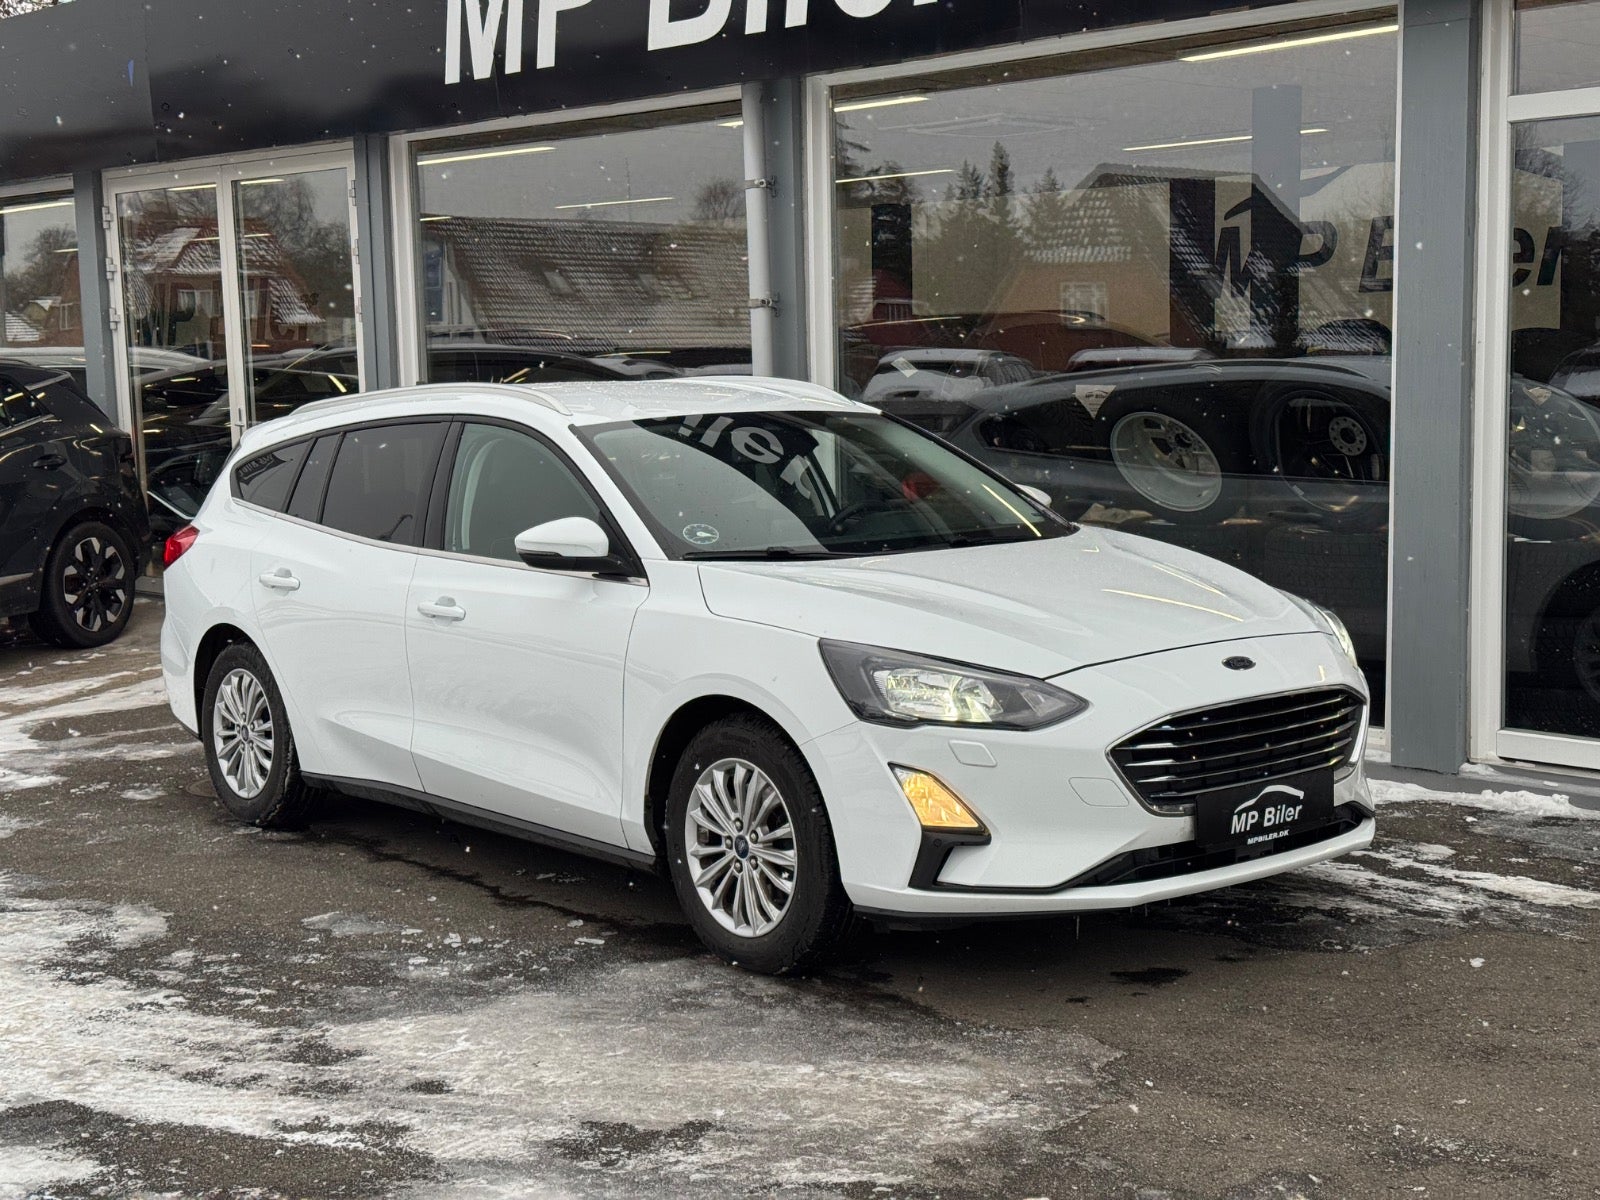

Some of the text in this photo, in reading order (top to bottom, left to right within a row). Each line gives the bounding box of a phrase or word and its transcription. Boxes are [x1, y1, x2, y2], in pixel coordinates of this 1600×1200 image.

[1231, 804, 1303, 834] MP Biler
[1247, 829, 1289, 845] MPBILER.DK
